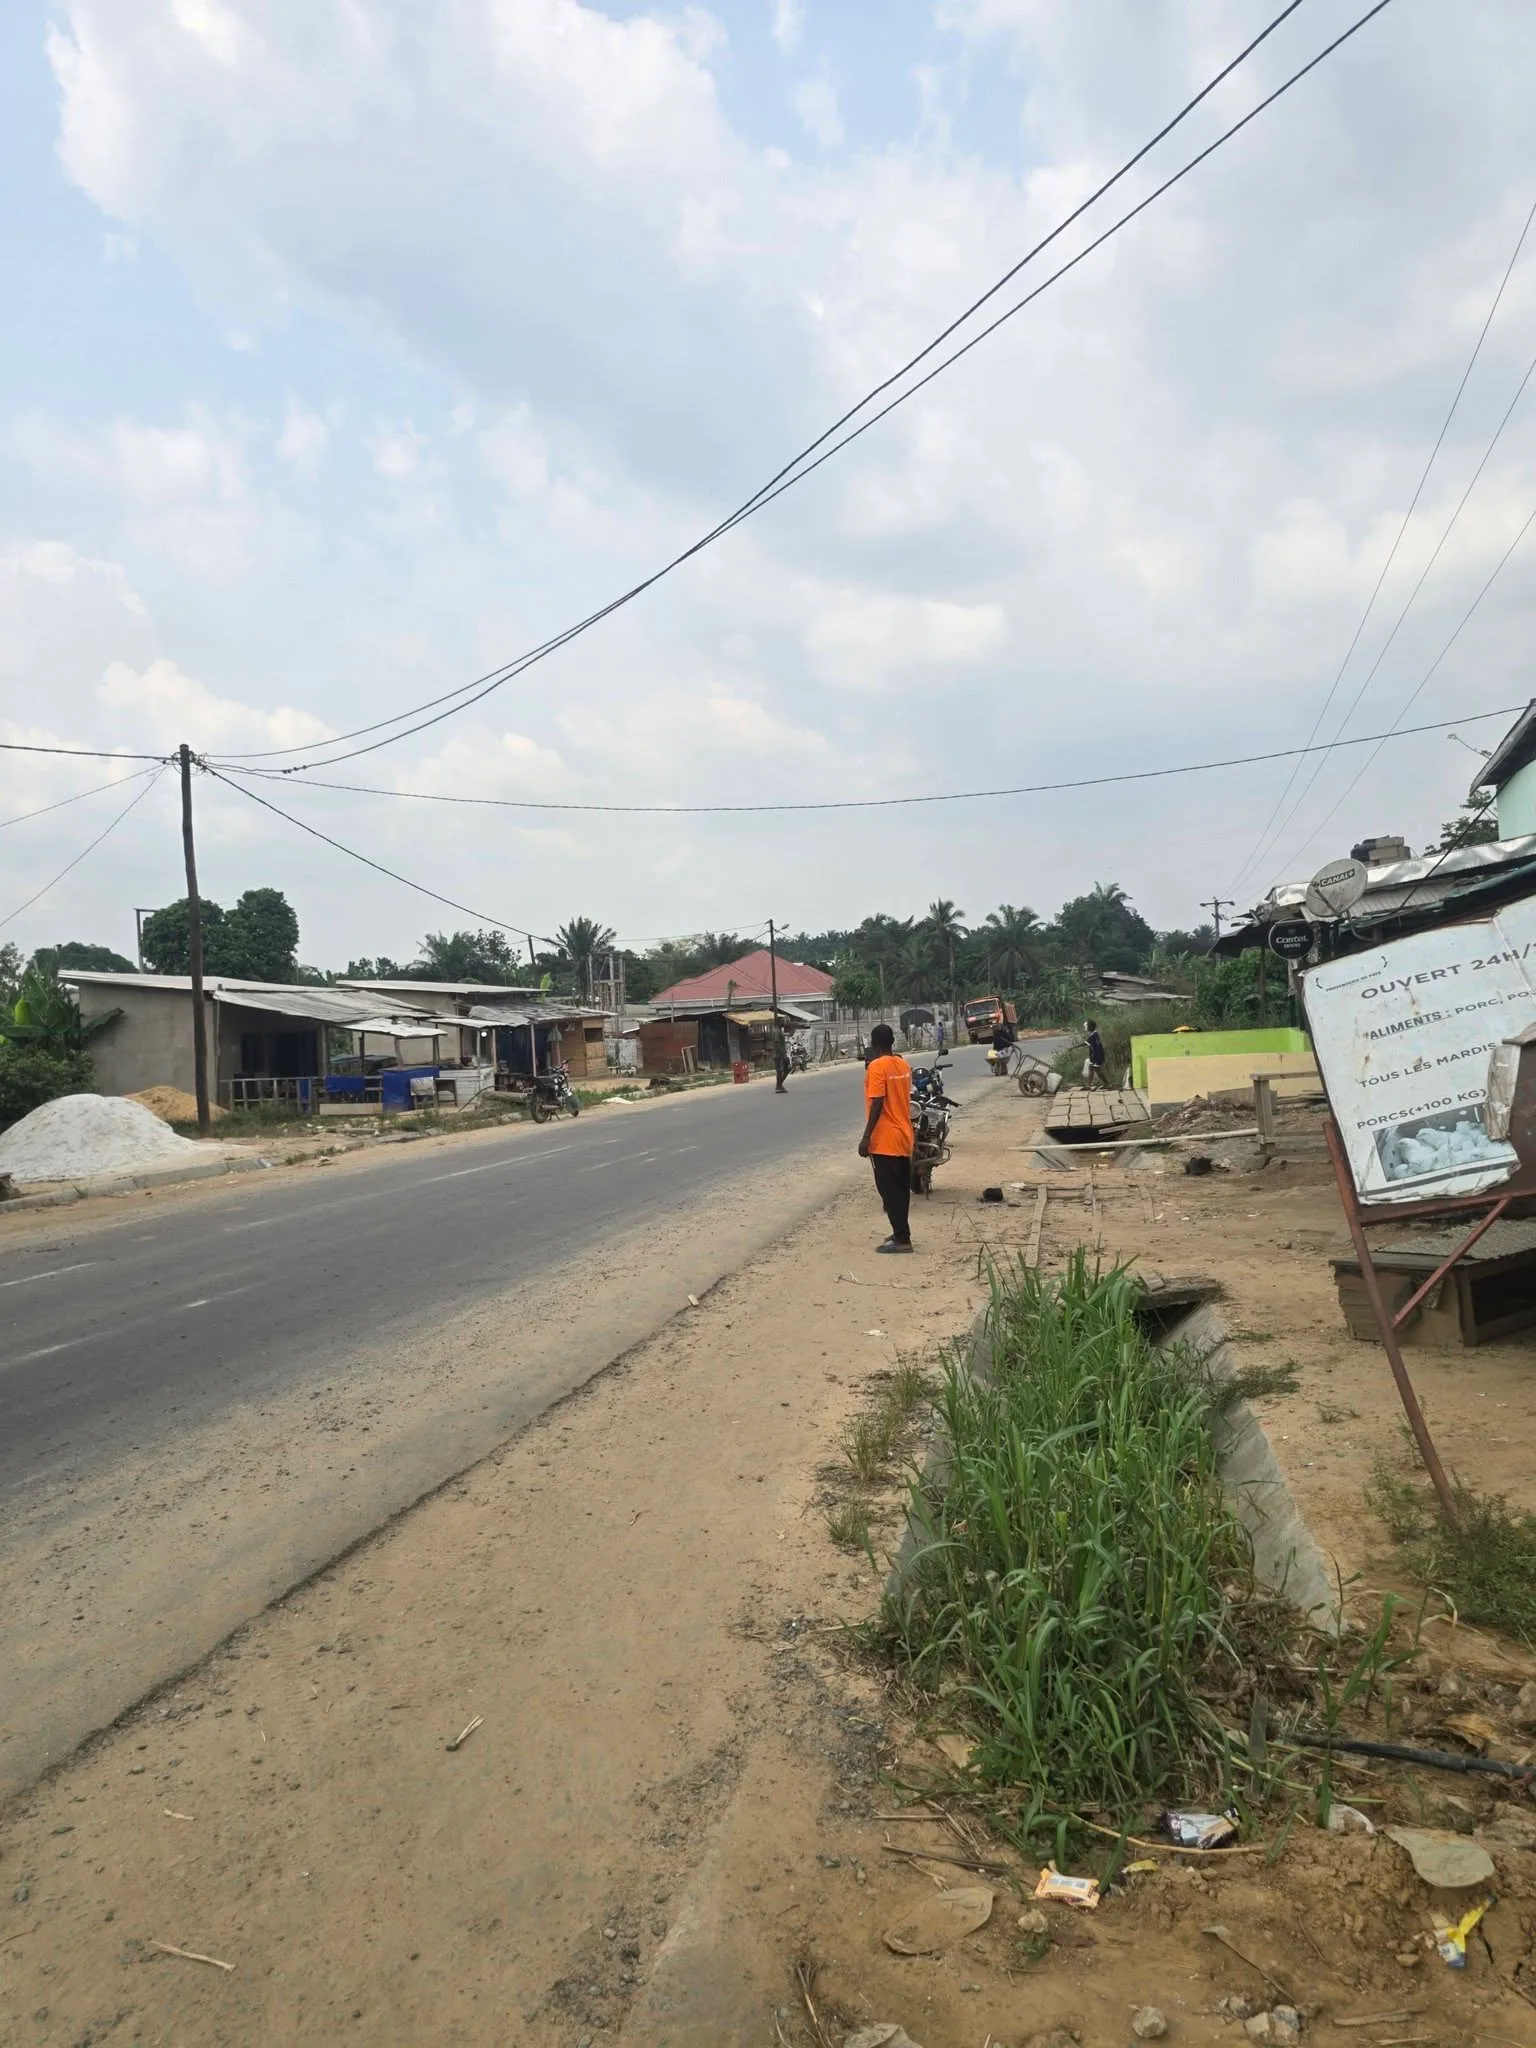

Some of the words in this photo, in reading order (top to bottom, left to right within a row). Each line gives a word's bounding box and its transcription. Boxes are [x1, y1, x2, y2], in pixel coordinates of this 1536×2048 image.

[1321, 869, 1355, 886] CANAL+
[1361, 964, 1461, 999] OUVERT
[1470, 942, 1536, 971] 24H/
[1359, 1071, 1400, 1088] TOUS
[1404, 1061, 1432, 1076] LES
[1436, 1042, 1497, 1066] MARDIS
